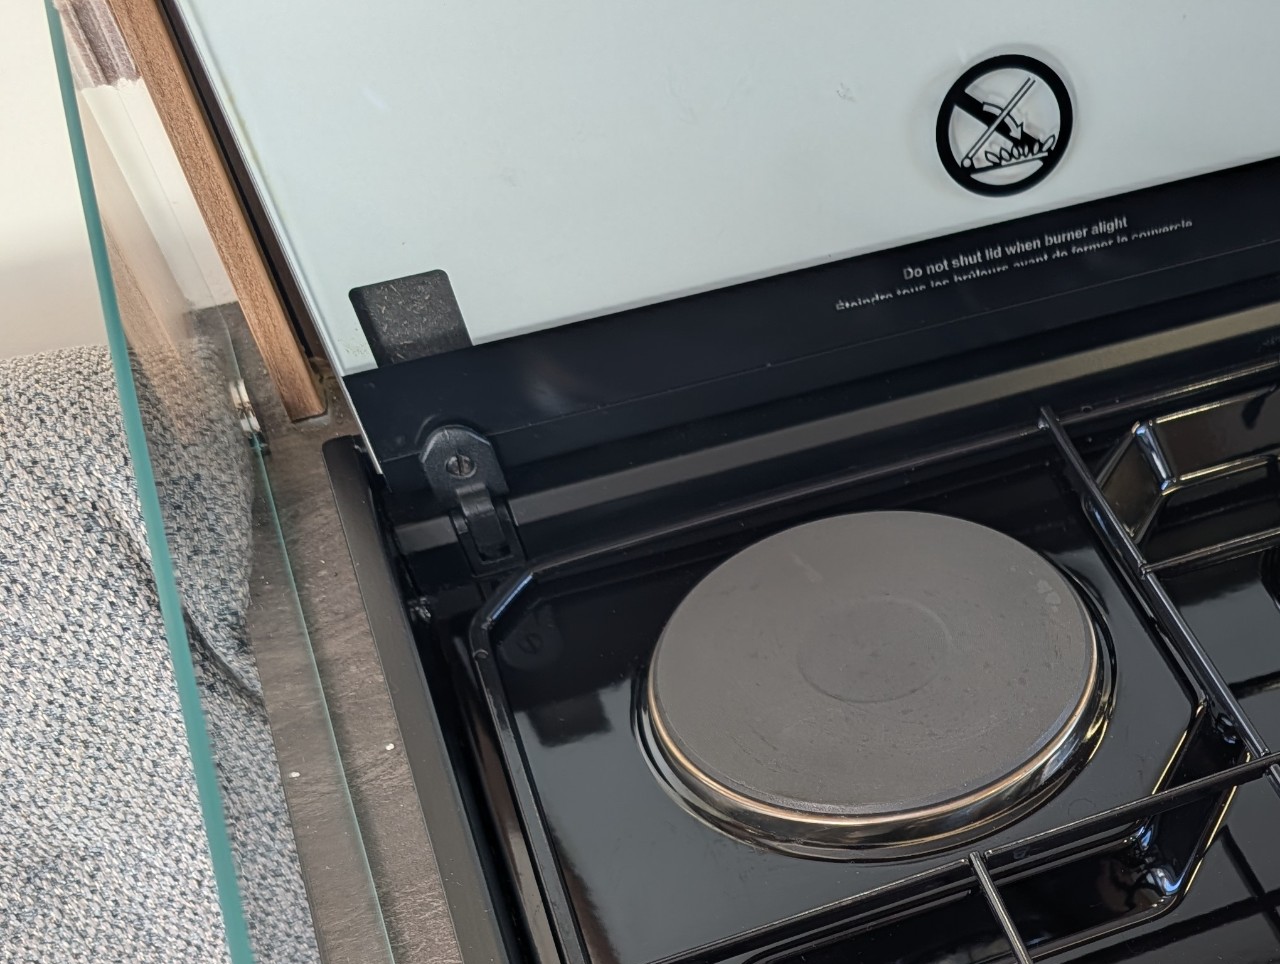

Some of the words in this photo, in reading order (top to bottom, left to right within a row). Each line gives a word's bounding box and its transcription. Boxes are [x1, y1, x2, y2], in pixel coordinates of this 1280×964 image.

[903, 265, 923, 280] Do
[926, 259, 950, 275] not
[952, 251, 983, 269] shut
[985, 245, 1002, 261] lid
[1005, 237, 1041, 255] when
[1044, 226, 1088, 246] burner
[1091, 216, 1128, 235] alight
